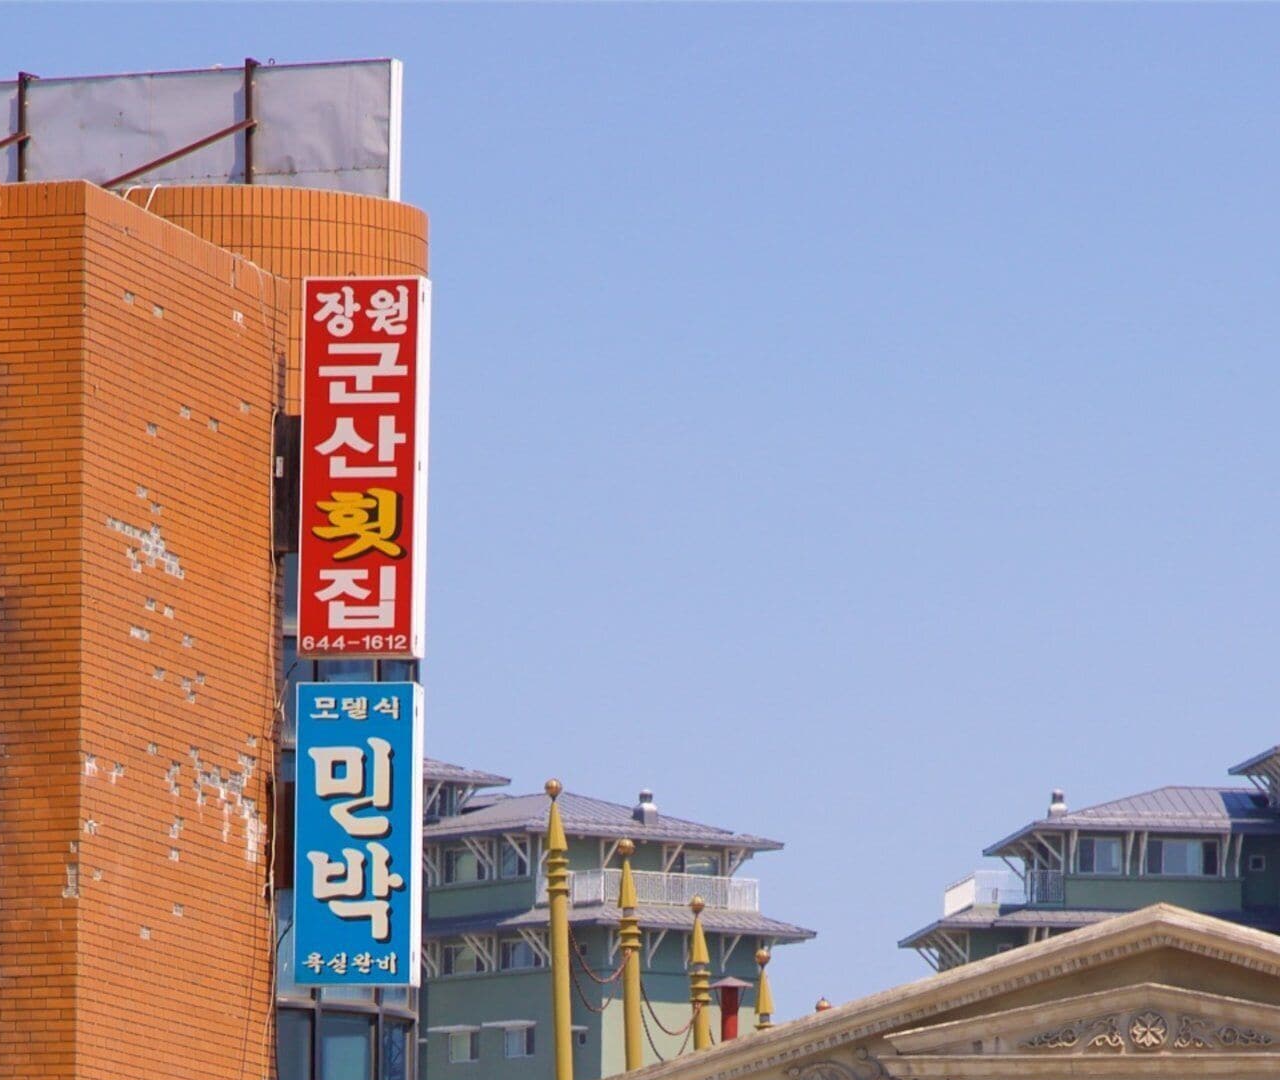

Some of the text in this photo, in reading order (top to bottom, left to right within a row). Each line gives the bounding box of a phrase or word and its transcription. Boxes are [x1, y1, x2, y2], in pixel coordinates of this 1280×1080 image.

[313, 285, 410, 337] 장원
[311, 341, 410, 630] 군산횟집
[302, 634, 407, 652] 644-1612
[309, 695, 401, 720] 모텔식
[307, 736, 405, 941] 민박
